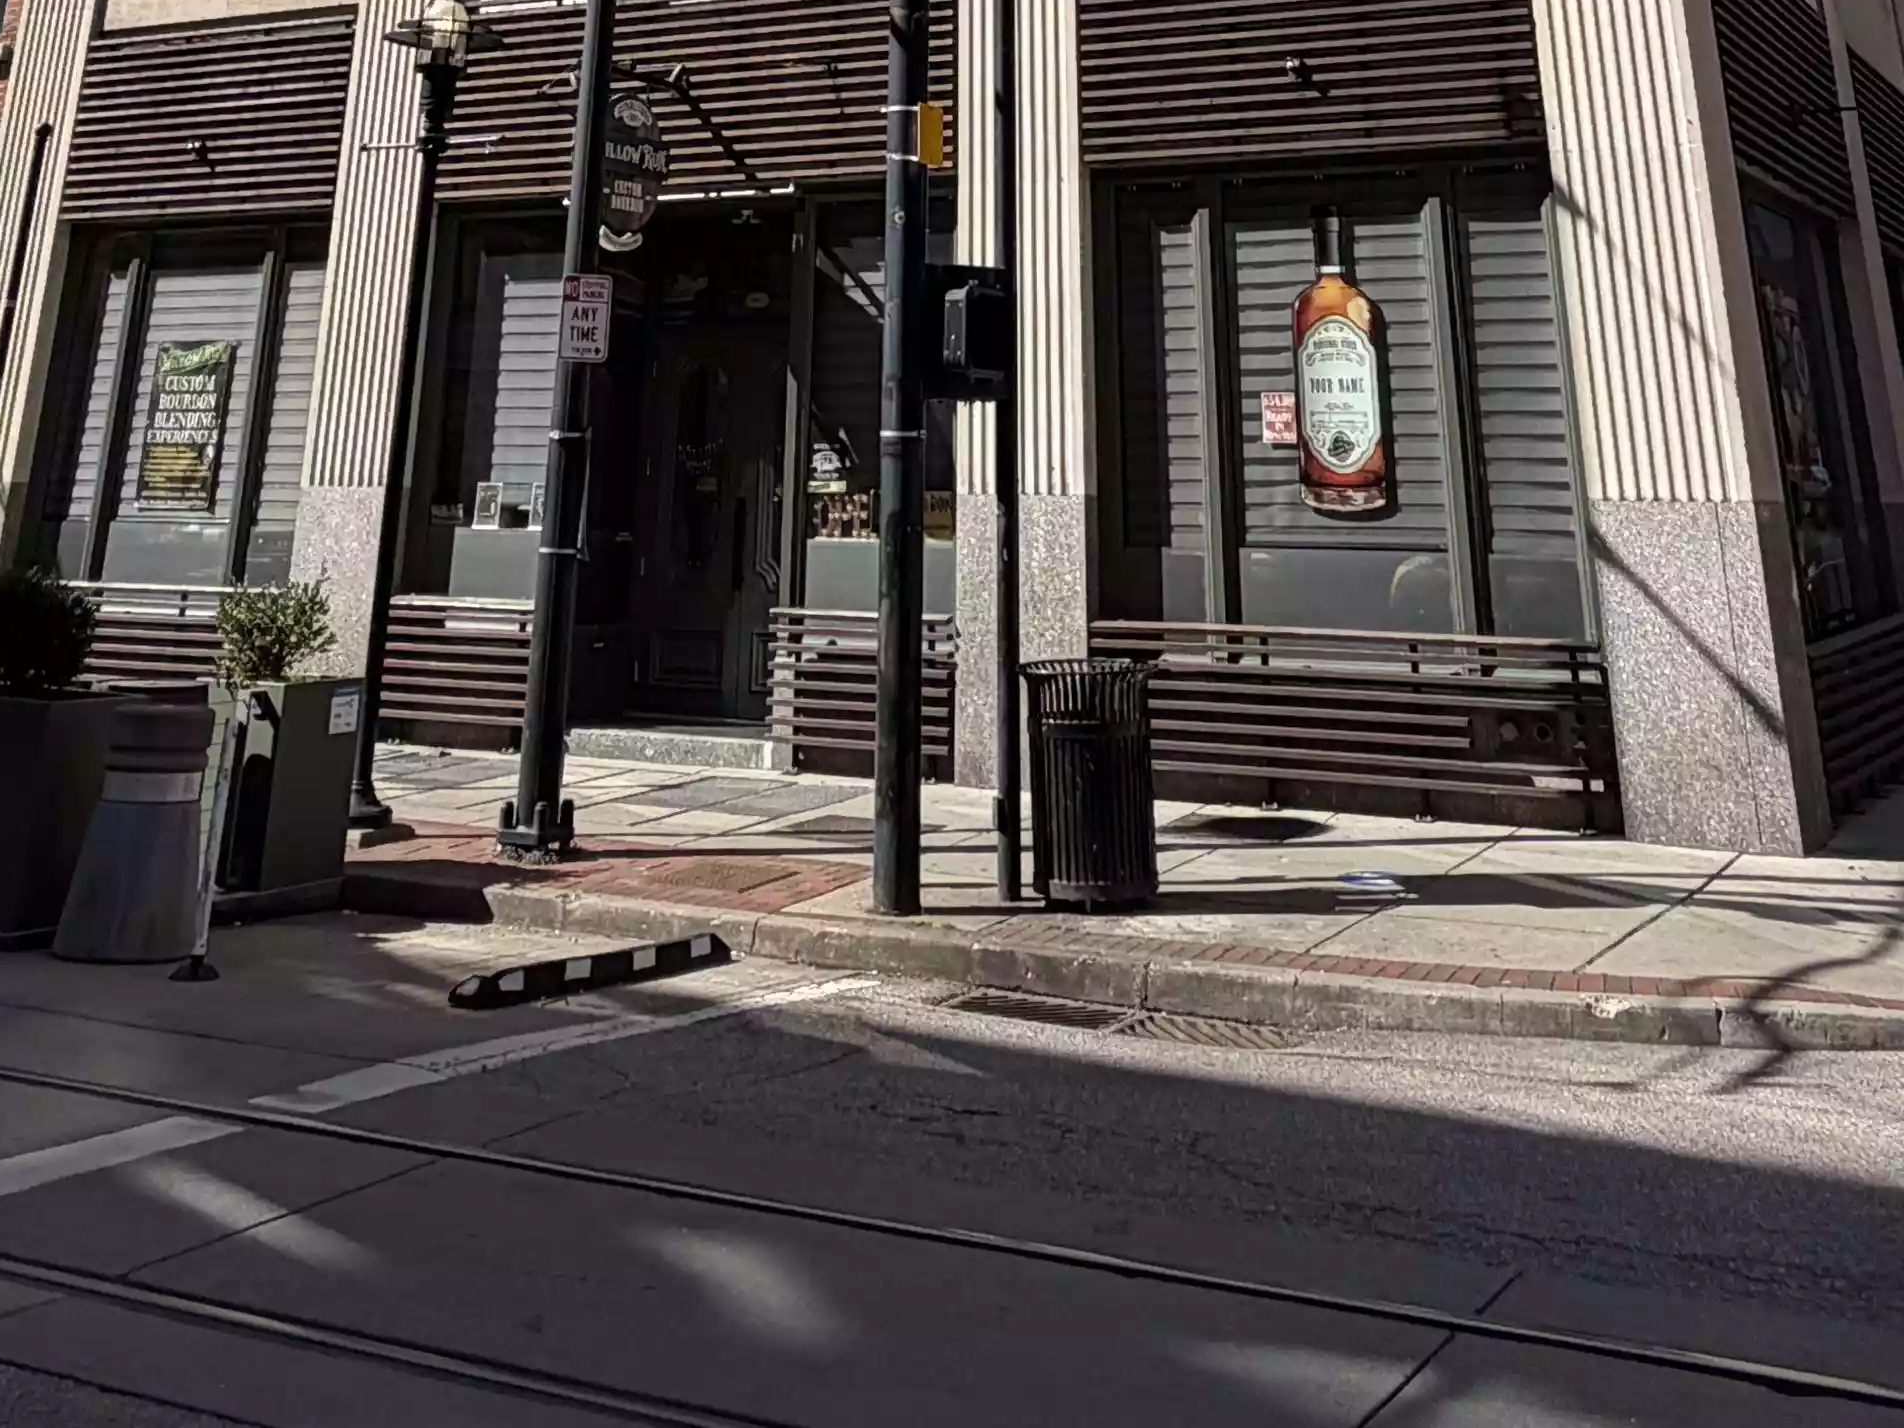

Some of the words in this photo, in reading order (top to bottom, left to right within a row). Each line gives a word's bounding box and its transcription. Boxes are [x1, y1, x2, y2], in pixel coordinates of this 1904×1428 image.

[604, 142, 641, 164] ILLOW
[571, 306, 598, 322] ANY
[569, 325, 599, 343] TIME
[164, 374, 216, 392] CUSTOM
[158, 393, 217, 409] BOURBON
[154, 411, 217, 429] BLENDING
